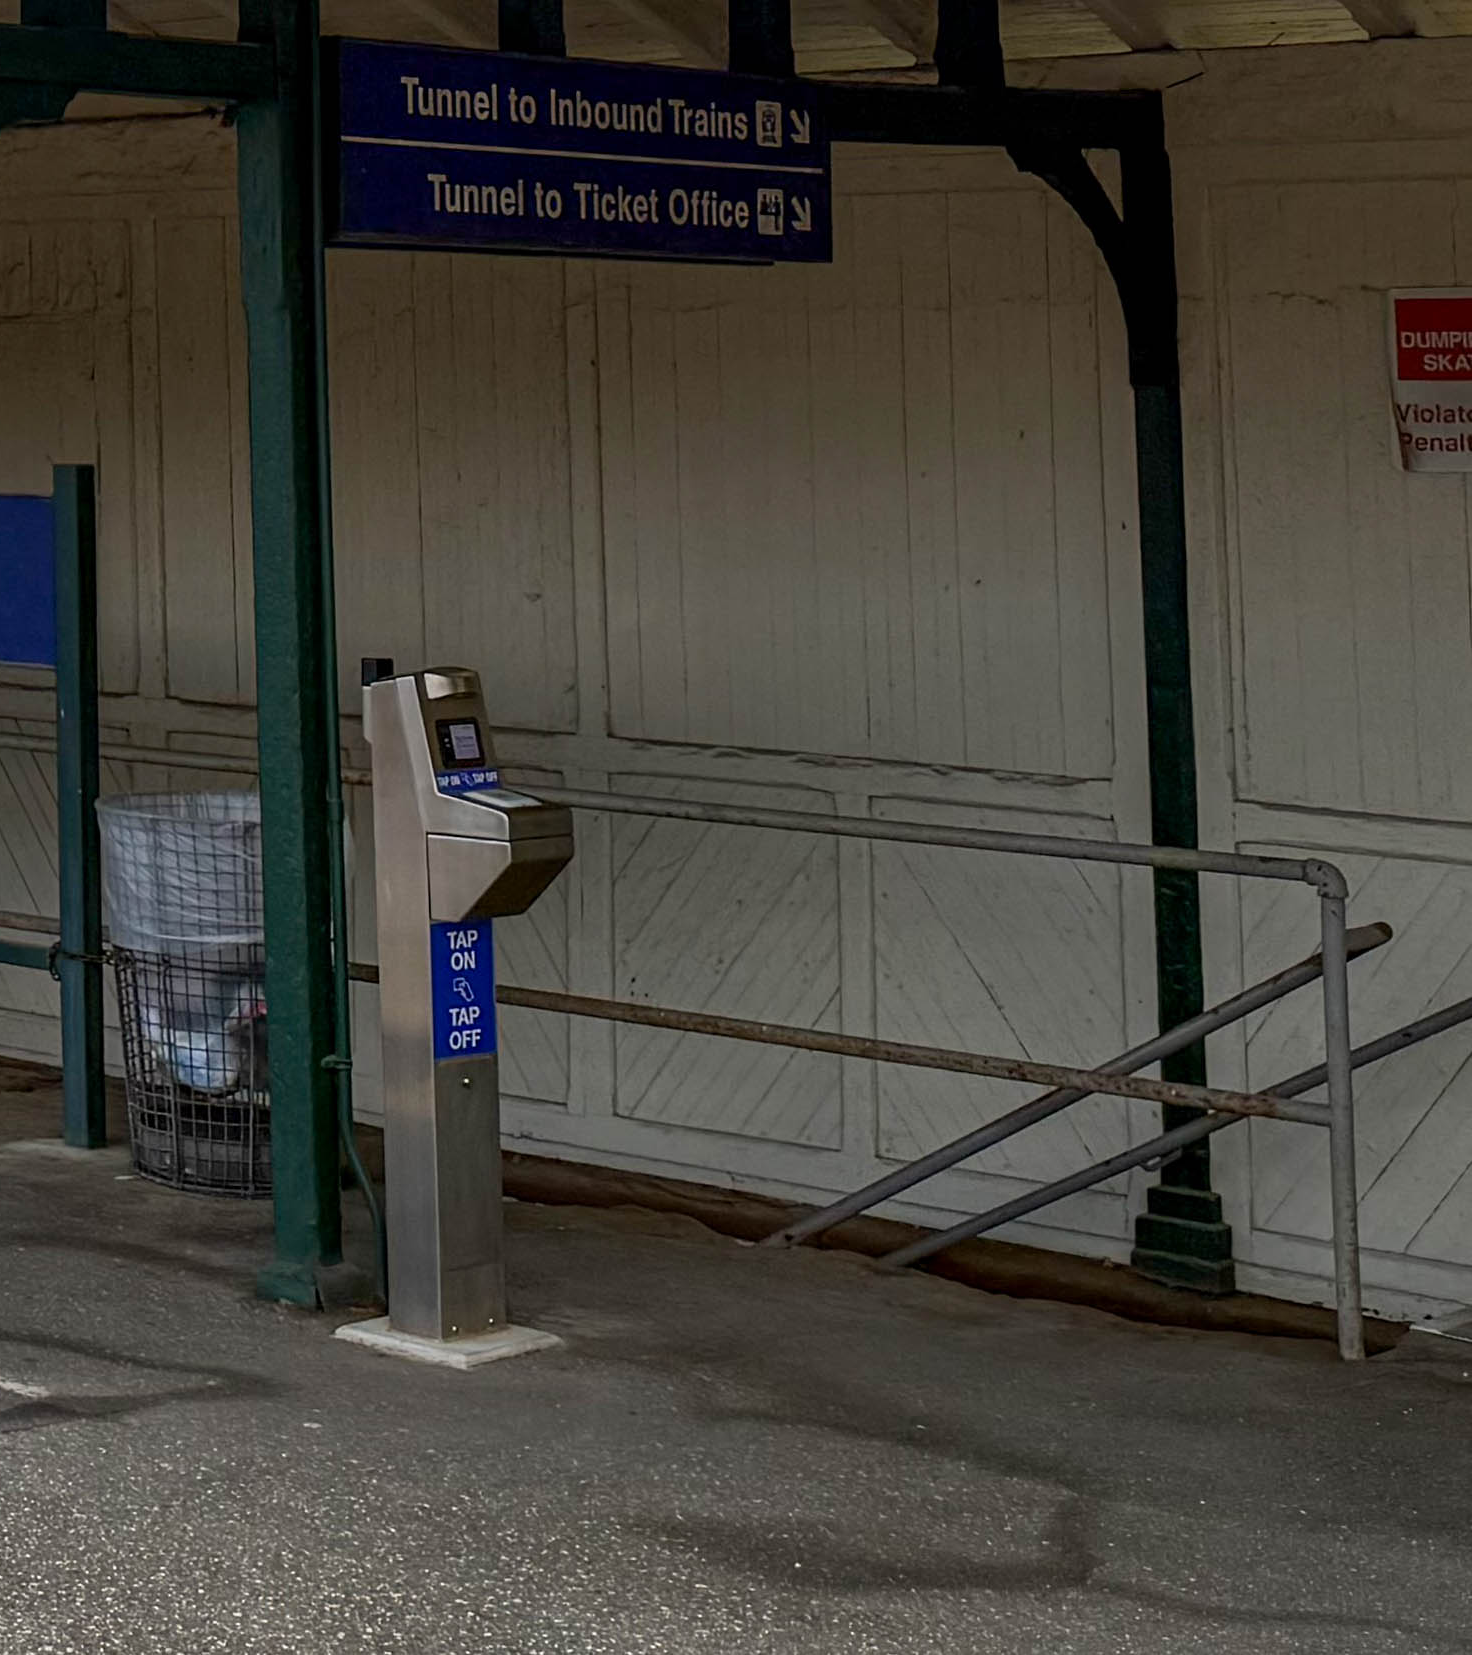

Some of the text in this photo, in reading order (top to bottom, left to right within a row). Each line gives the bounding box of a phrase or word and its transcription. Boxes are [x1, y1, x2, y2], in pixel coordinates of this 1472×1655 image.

[400, 75, 750, 141] Tunnel to Inbound Trains
[426, 172, 750, 229] Tunnel to Ticket Office
[446, 929, 479, 950] TAP
[450, 950, 476, 971] ON
[448, 1006, 481, 1027] TAP
[449, 1028, 482, 1050] OFF
